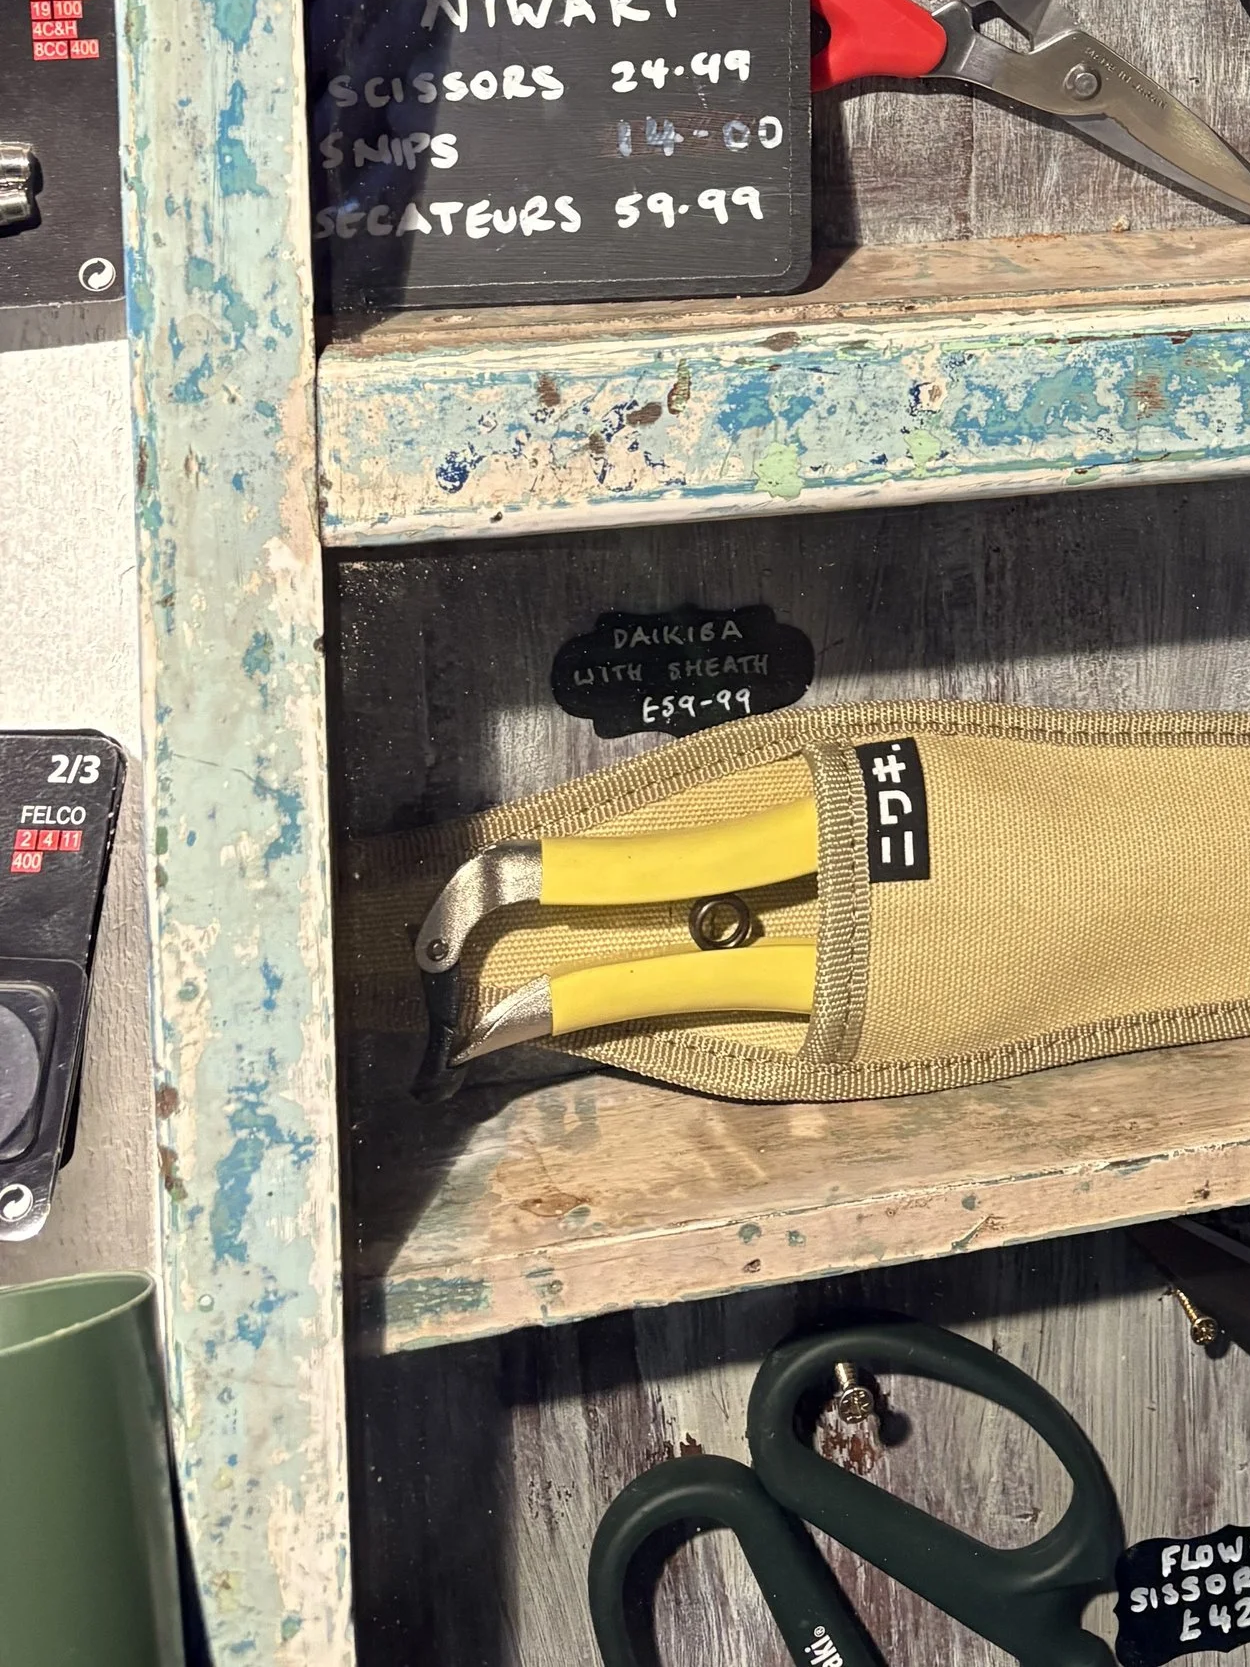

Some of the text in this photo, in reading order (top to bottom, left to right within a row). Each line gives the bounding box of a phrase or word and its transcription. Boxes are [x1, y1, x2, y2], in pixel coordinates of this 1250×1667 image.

[33, 1, 82, 17] 19 100
[32, 21, 77, 37] 4C&H
[34, 40, 98, 57] 8CC 400
[328, 64, 565, 108] SCISSORS
[320, 131, 459, 170] SNIPS
[315, 186, 763, 239] SECATEURS 59.99
[573, 653, 769, 685] WITH SHEATH
[47, 754, 101, 784] 2/3
[20, 805, 87, 825] FELCO
[20, 831, 78, 848] 2 4 11
[12, 853, 42, 870] 400
